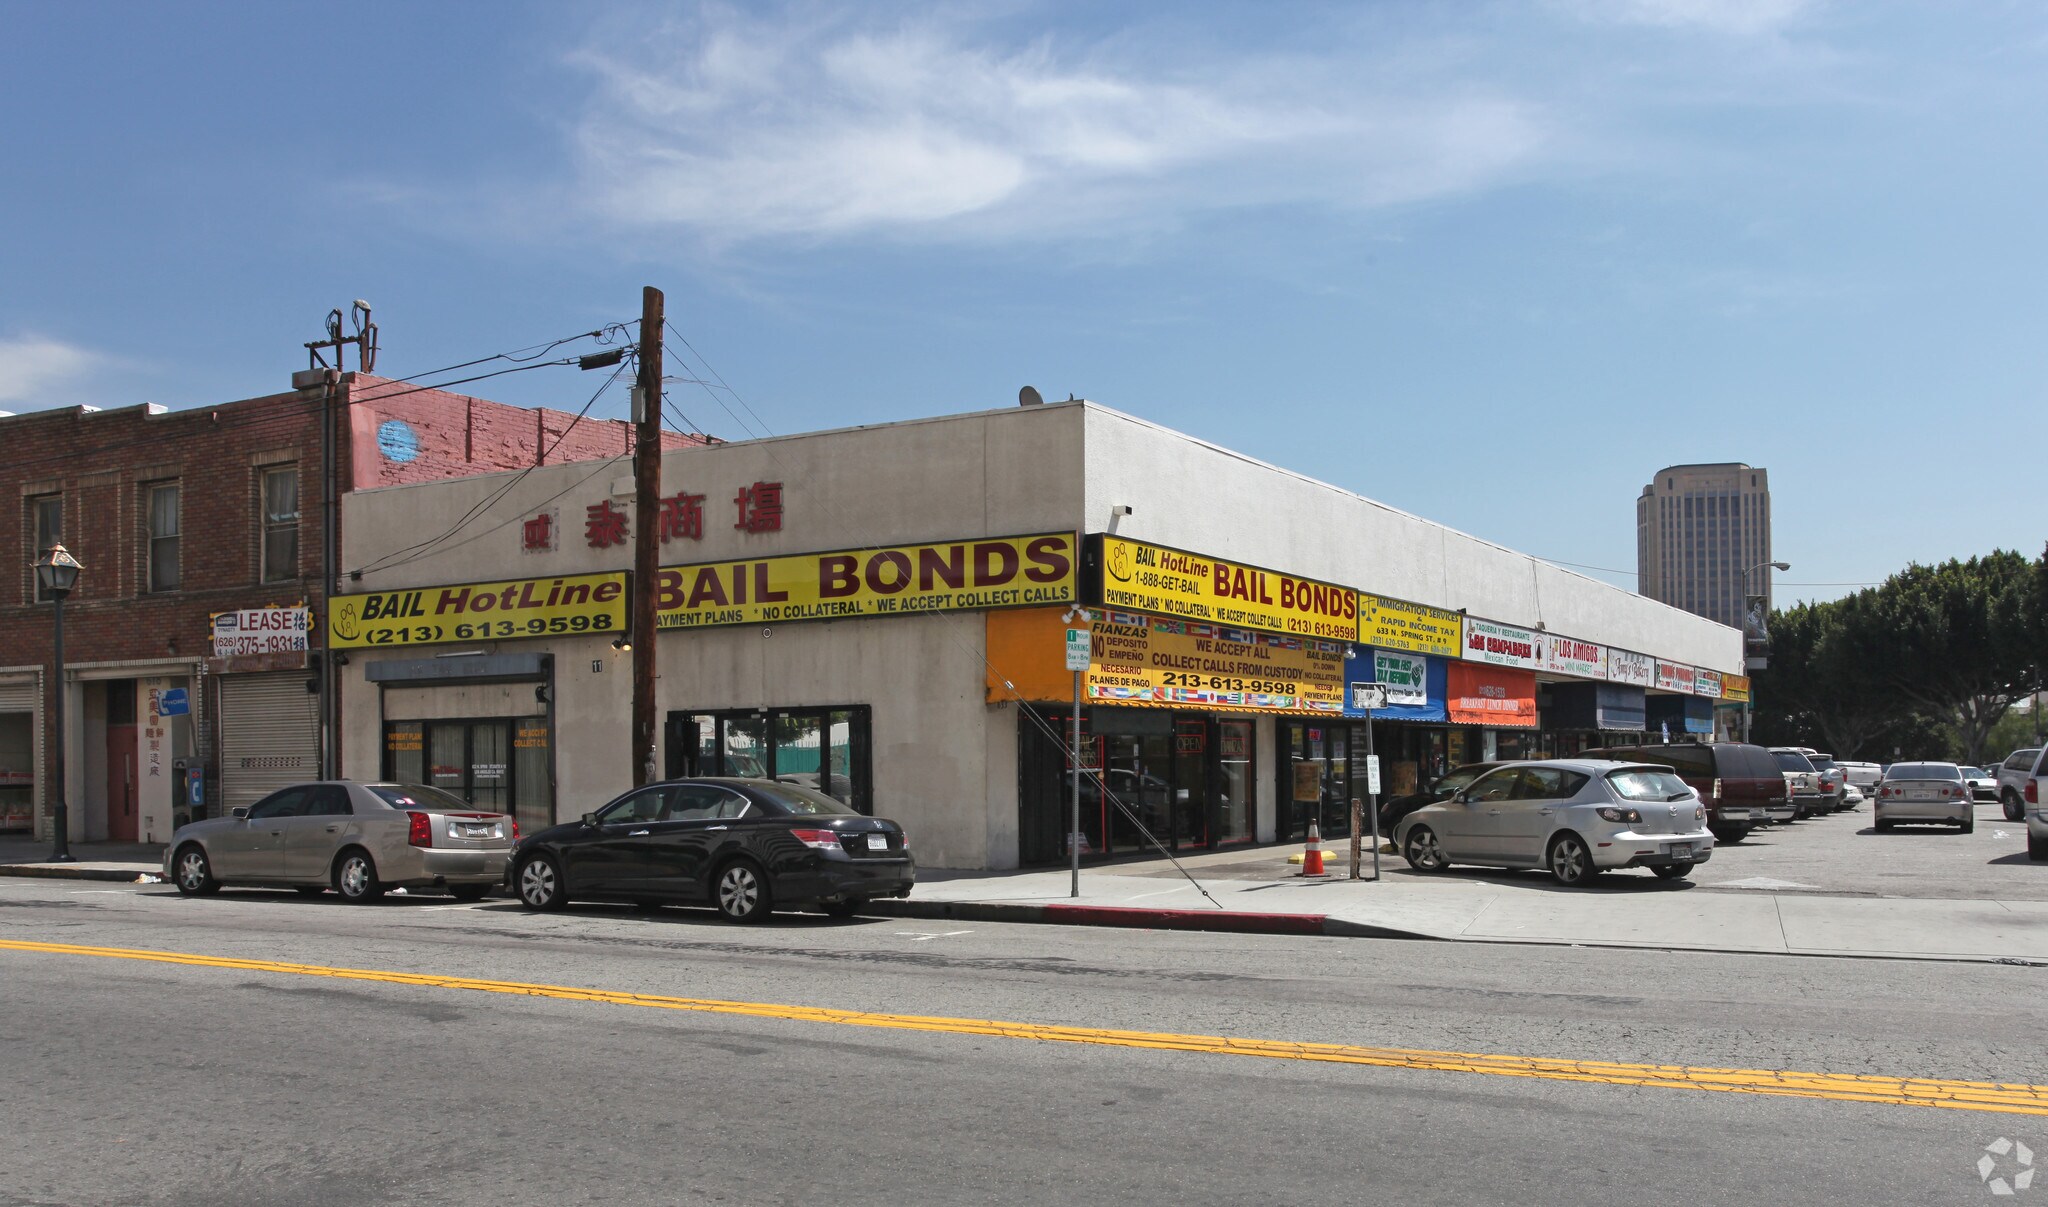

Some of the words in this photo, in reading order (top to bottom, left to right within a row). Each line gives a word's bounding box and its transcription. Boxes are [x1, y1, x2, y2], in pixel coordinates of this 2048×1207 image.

[657, 563, 788, 610] BAIL
[819, 537, 1070, 598] BONDS
[1135, 546, 1156, 568] BAIL
[1160, 551, 1208, 577] HotLine
[1213, 563, 1273, 605] BAIL
[1281, 577, 1355, 620] BONDS
[1135, 570, 1200, 596] 1-888-GET-BAIL
[361, 592, 425, 620] BAIL
[435, 580, 622, 615] HotLine
[656, 612, 702, 628] AYMENT
[705, 610, 743, 624] PLANS
[763, 605, 780, 619] NO
[783, 600, 864, 618] COLLATERAL
[876, 597, 898, 612] WE
[900, 594, 951, 611] ACCEPT
[956, 589, 1019, 607] COLLECT
[1023, 586, 1069, 602] CALLS
[1106, 589, 1137, 607] PAYMENT
[1139, 595, 1159, 610] PLANS
[1165, 598, 1174, 611] NO
[1175, 600, 1211, 619] COLLATERAL
[1217, 607, 1226, 620] WE
[1227, 609, 1247, 625] ACCEPT
[1268, 614, 1282, 629] CALLS
[1287, 617, 1312, 634] (213)
[1315, 621, 1355, 640] 613-9598
[1376, 598, 1427, 617] IMMIGRATION
[1429, 610, 1459, 623] SERVICES
[240, 611, 292, 631] LEASE
[365, 625, 443, 645] (213)
[455, 614, 613, 639] 613-9598
[1092, 622, 1148, 638] FIANZAS
[1381, 616, 1406, 628] RAPID
[1409, 621, 1438, 634] INCOME
[1440, 627, 1455, 637] TAX
[1376, 627, 1389, 636] 633
[1391, 629, 1399, 637] N.
[1401, 631, 1423, 641] SPRING
[1476, 623, 1497, 635] TAQUERIA
[1502, 629, 1531, 641] RESTAURANTE
[215, 636, 236, 648] (626)
[237, 636, 293, 655] 375-1931
[1068, 643, 1088, 652] PARKING
[1092, 635, 1104, 658] NO
[1107, 637, 1148, 649] DEPOSITO
[1196, 639, 1213, 653] WE
[1215, 641, 1251, 658] ACCEPT
[1254, 645, 1270, 660] ALL
[1559, 639, 1572, 659] LOS
[1573, 643, 1598, 664] AMIGOS
[1109, 649, 1144, 661] EMPEÑO
[1306, 651, 1321, 661] BAIL
[1322, 652, 1342, 662] BONDS
[1377, 656, 1387, 668] GET
[1484, 652, 1504, 663] Mexican
[1506, 656, 1518, 665] Food
[1101, 664, 1141, 675] NECESARIO
[1152, 652, 1201, 671] COLLECT
[1203, 657, 1235, 675] CALLS
[1238, 660, 1262, 677] FROM
[1264, 662, 1303, 680] CUSTODY
[1320, 663, 1335, 671] DOWN
[1090, 675, 1119, 685] PLANES
[1121, 678, 1130, 686] DE
[1132, 679, 1150, 688] PAGO
[1162, 672, 1296, 695] 213-613-9598
[1305, 672, 1311, 680] NO
[1312, 672, 1342, 682] COLLATERAL
[1377, 669, 1388, 683] TAX
[1304, 691, 1324, 700] PAYMENT
[1326, 692, 1342, 701] PLANS
[1461, 697, 1486, 709] BREAKFAST
[1503, 699, 1519, 712] DINNER
[514, 739, 536, 748] COLLECT
[1176, 736, 1200, 751] OPEN
